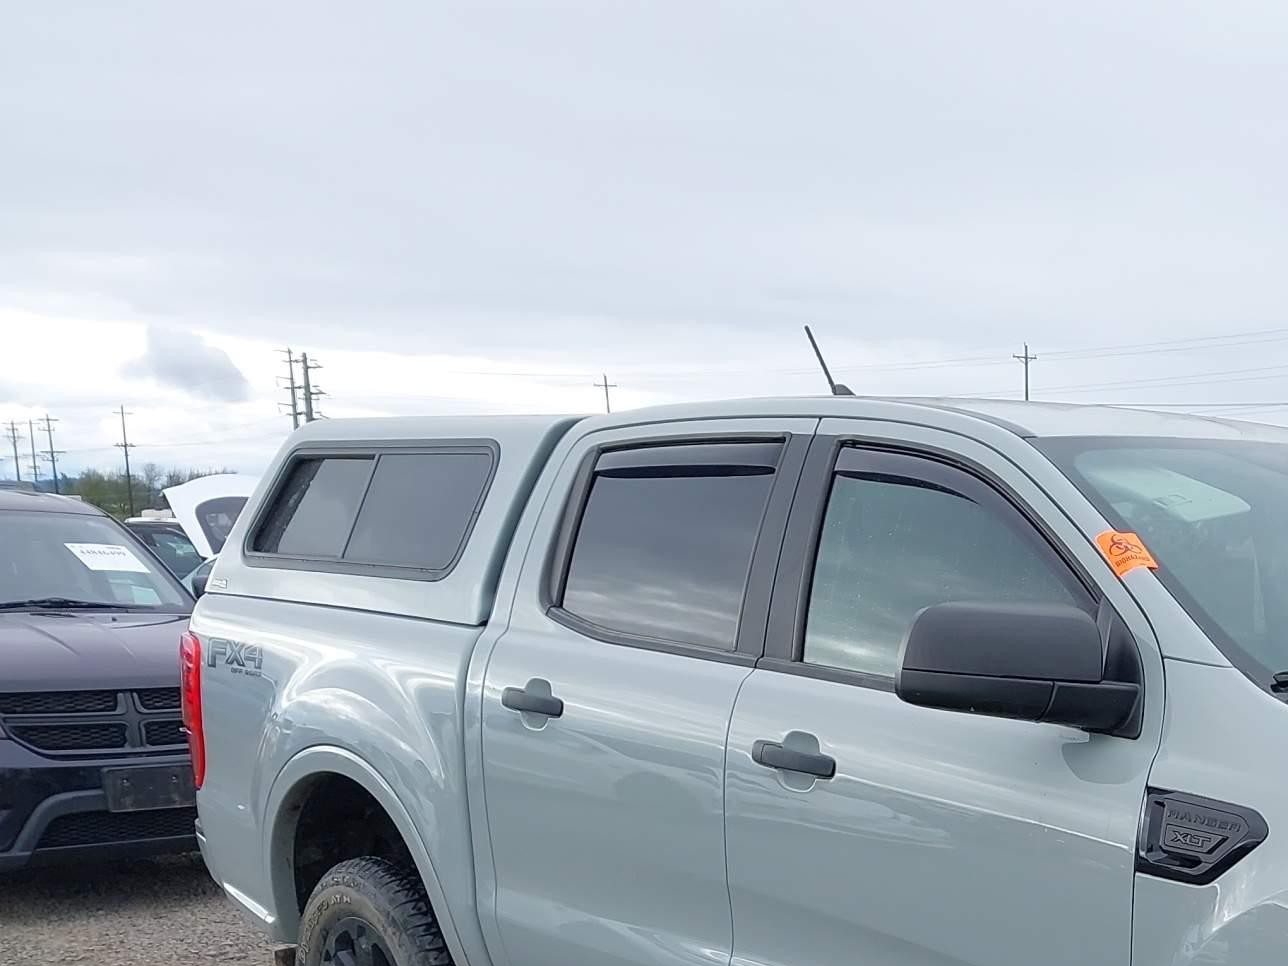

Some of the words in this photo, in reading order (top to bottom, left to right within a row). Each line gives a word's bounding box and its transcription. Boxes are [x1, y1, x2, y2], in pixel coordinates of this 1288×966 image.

[206, 637, 263, 670] FX4
[1167, 809, 1241, 833] RANGER
[1170, 830, 1212, 849] XLT
